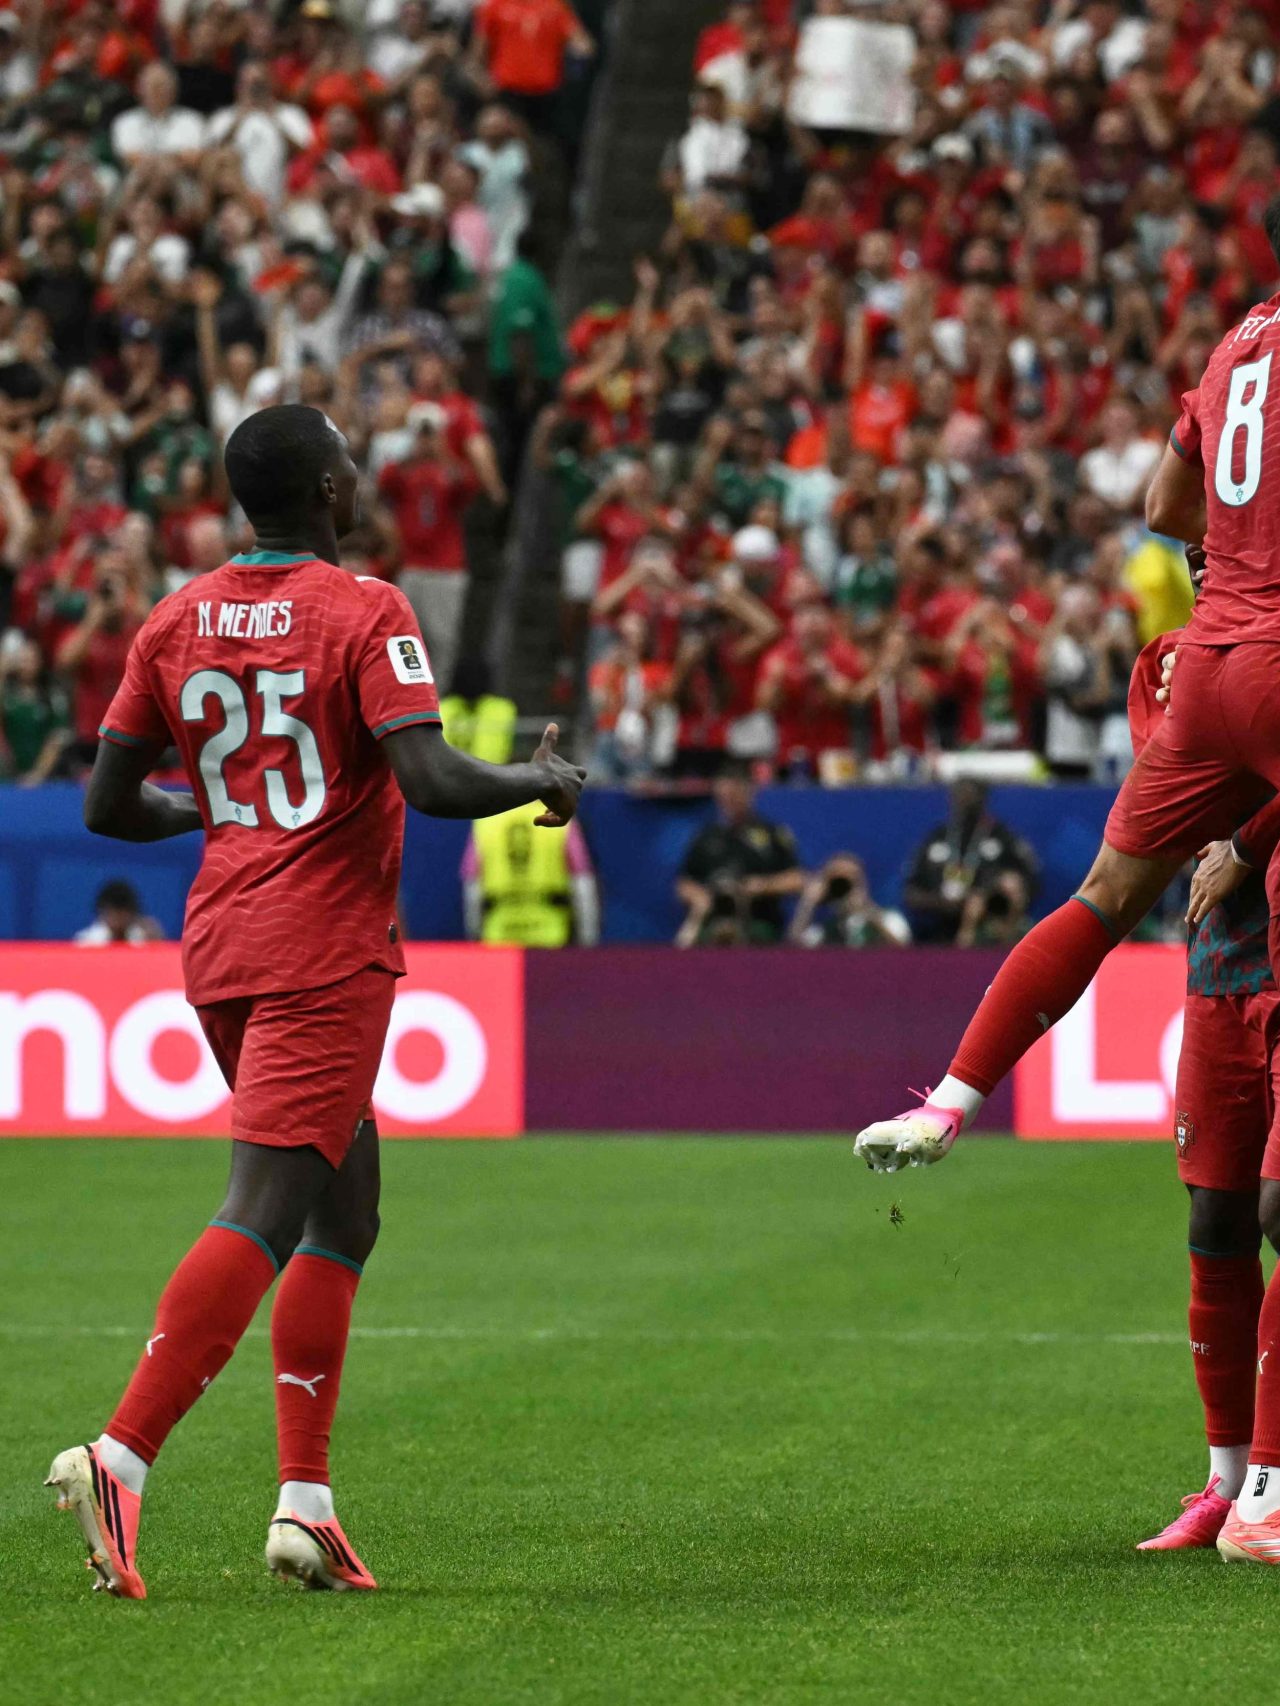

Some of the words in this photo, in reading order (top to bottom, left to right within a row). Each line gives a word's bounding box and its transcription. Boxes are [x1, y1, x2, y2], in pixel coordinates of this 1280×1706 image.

[1215, 351, 1273, 506] 8
[198, 601, 214, 636] N.
[217, 601, 293, 639] MENDES
[181, 669, 326, 830] 25
[0, 989, 487, 1123] noo
